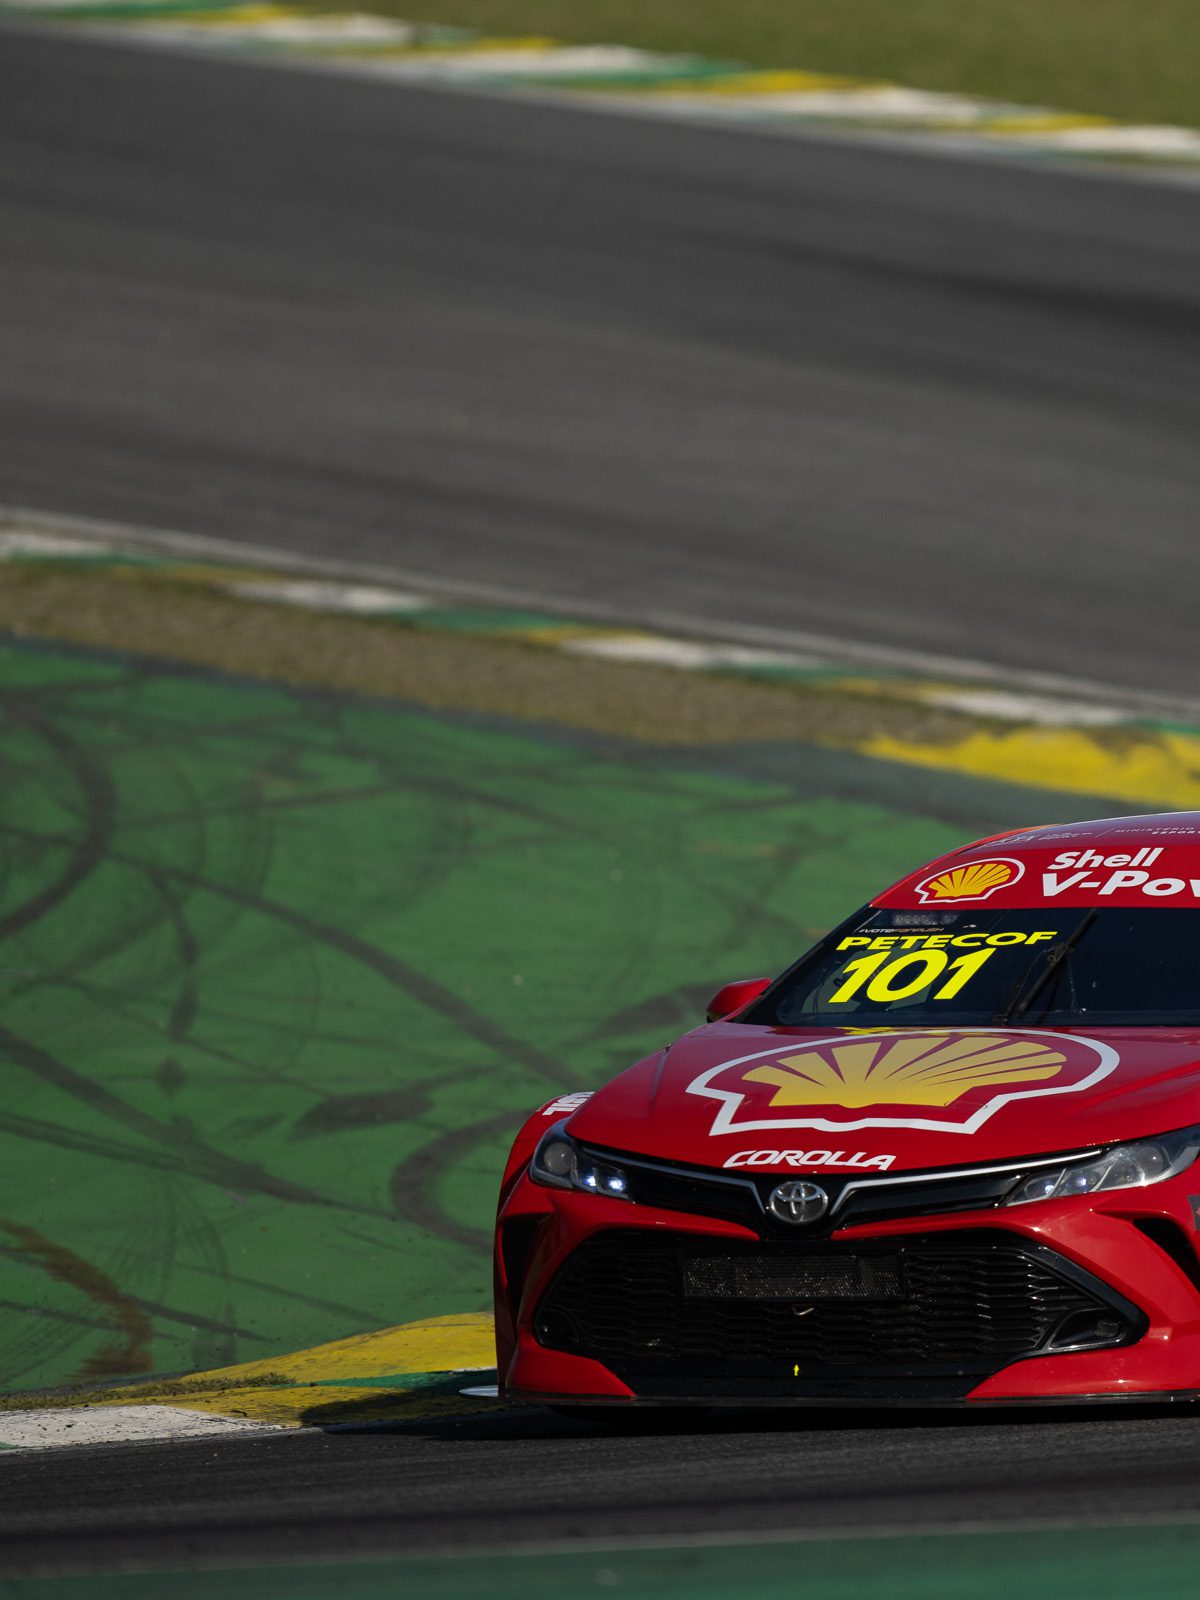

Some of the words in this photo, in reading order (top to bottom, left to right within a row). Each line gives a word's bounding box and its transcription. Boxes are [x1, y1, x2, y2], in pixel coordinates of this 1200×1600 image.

[1047, 847, 1165, 870] Shell
[836, 931, 1059, 951] PETECOF
[828, 947, 997, 1003] 101
[722, 1150, 897, 1171] COROLLA
